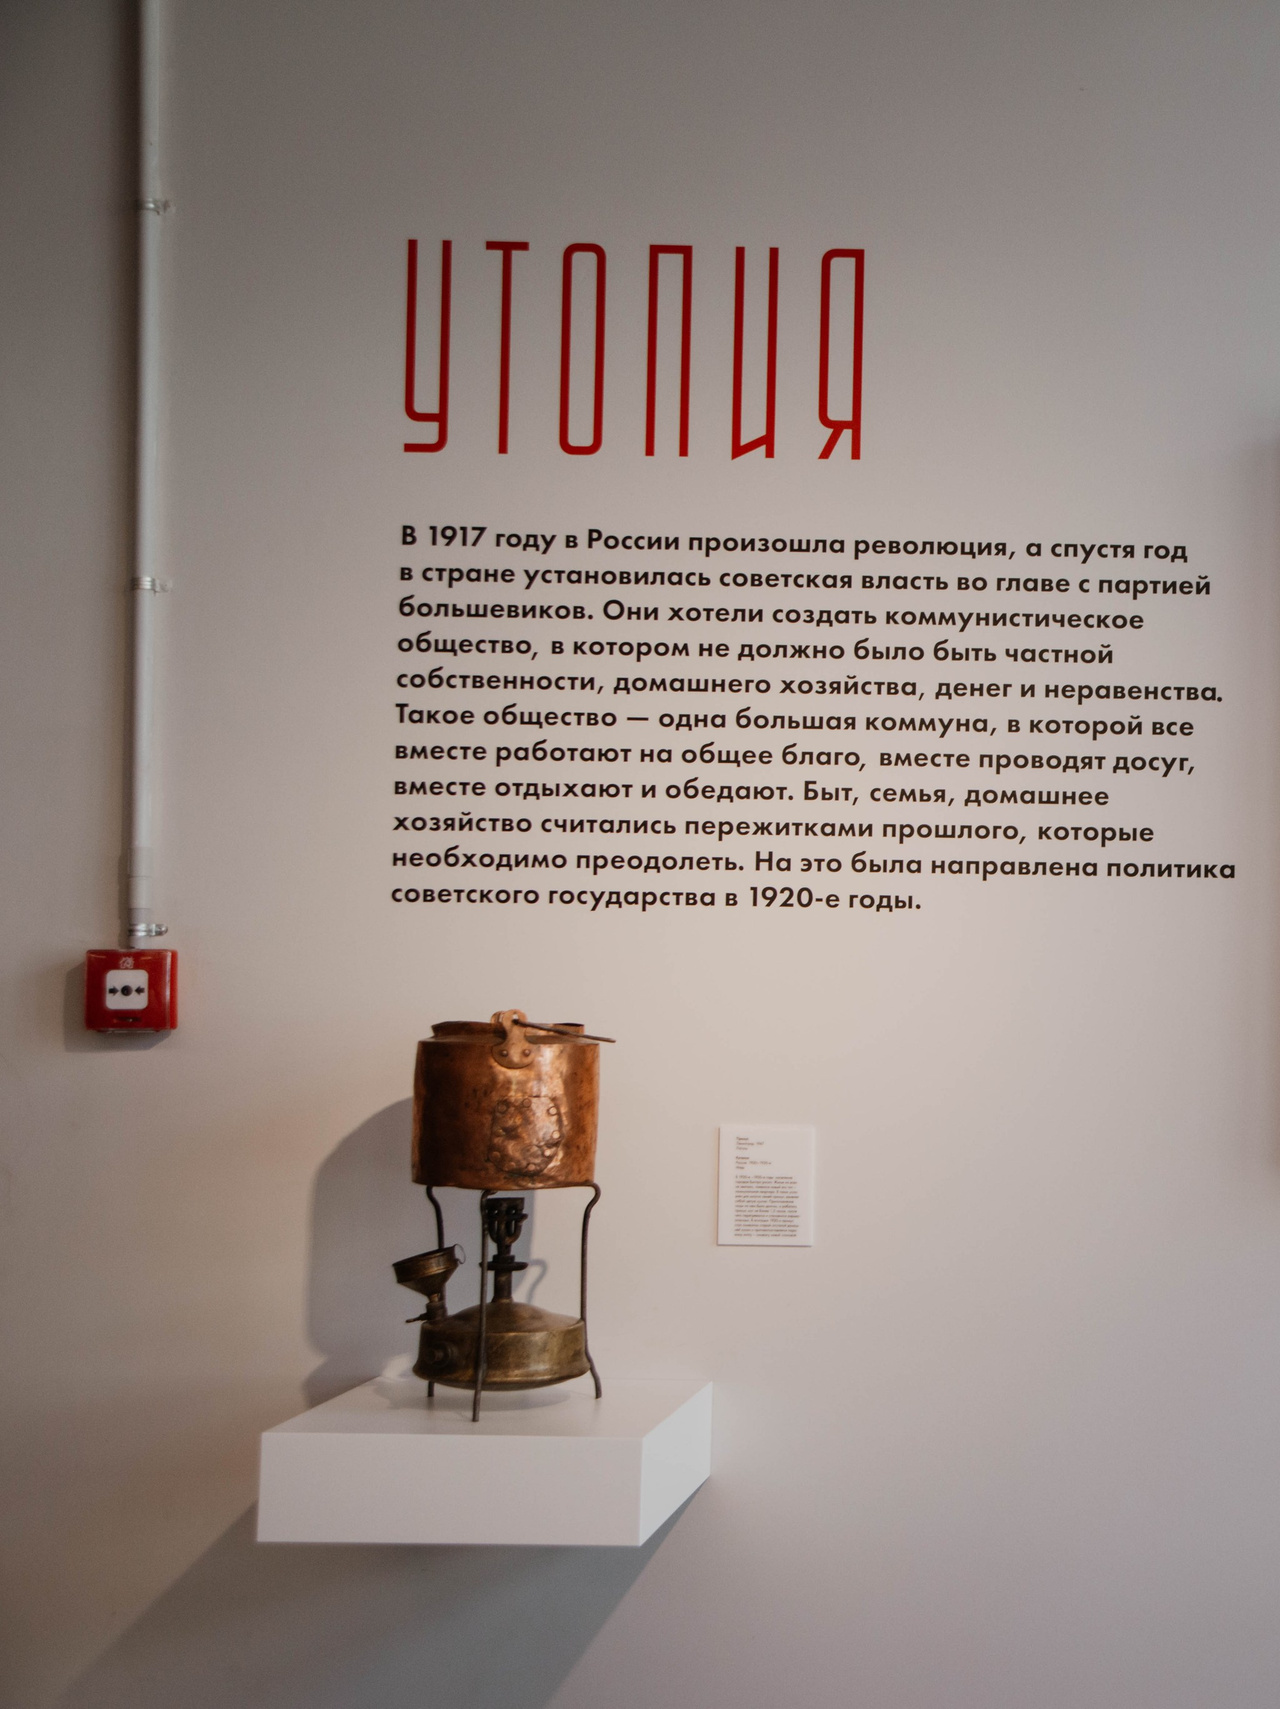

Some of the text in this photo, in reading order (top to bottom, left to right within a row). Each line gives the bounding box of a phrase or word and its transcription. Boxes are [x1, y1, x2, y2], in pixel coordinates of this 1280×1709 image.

[404, 239, 865, 460] УТОПИЯ
[402, 526, 1187, 563] В 1917 году в России произошла революция, а спустя год
[401, 567, 1210, 600] в стране установилась советская власть во главе с партией
[399, 595, 1143, 632] большевиков. Они хотели создать коммунистическое
[398, 631, 1112, 663] общество, в котором не должно было быть частной
[397, 667, 1222, 705] собственности, домашнего хозяйства, денег и неравенства.
[395, 704, 474, 724] Такое
[484, 703, 616, 728] общество
[659, 714, 725, 731] одна
[736, 707, 855, 730] большая
[866, 717, 996, 738] коммуна,
[1008, 720, 1020, 732] в
[1030, 715, 1142, 741] которой
[1152, 722, 1193, 736] все
[396, 739, 1194, 777] вместе работают на общее благо, вместе проводят досуг,
[395, 777, 1108, 806] вместе отдыхают и обедают. Быт, семья, домашнее
[393, 812, 1153, 847] хозяйство считались пережитками прошлого, которые
[393, 845, 1235, 881] необходимо преодолеть. На это была направлена политика
[392, 887, 920, 912] советского государства в 1920-е годы.
